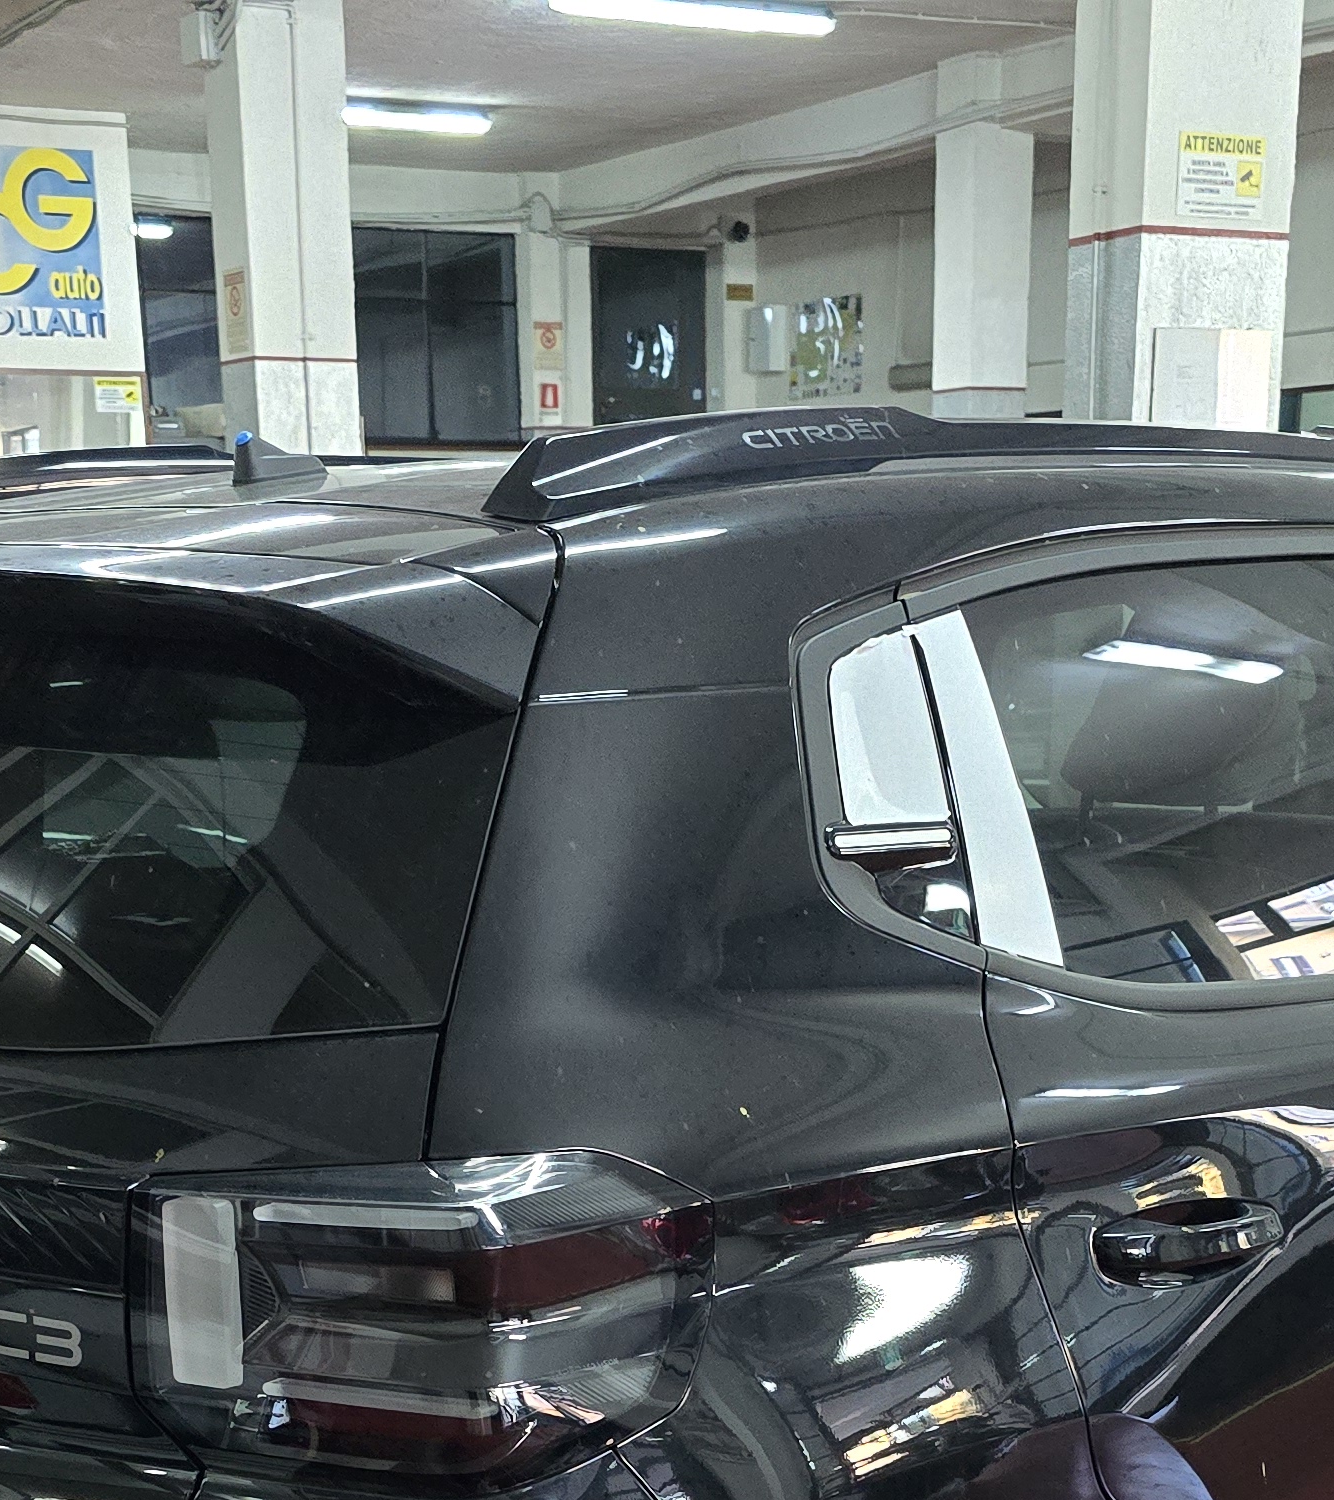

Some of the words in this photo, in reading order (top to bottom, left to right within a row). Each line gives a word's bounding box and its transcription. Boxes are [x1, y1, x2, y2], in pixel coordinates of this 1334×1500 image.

[1184, 134, 1262, 155] ATTENZIONE
[49, 266, 102, 301] auto
[741, 414, 903, 449] CITROËN
